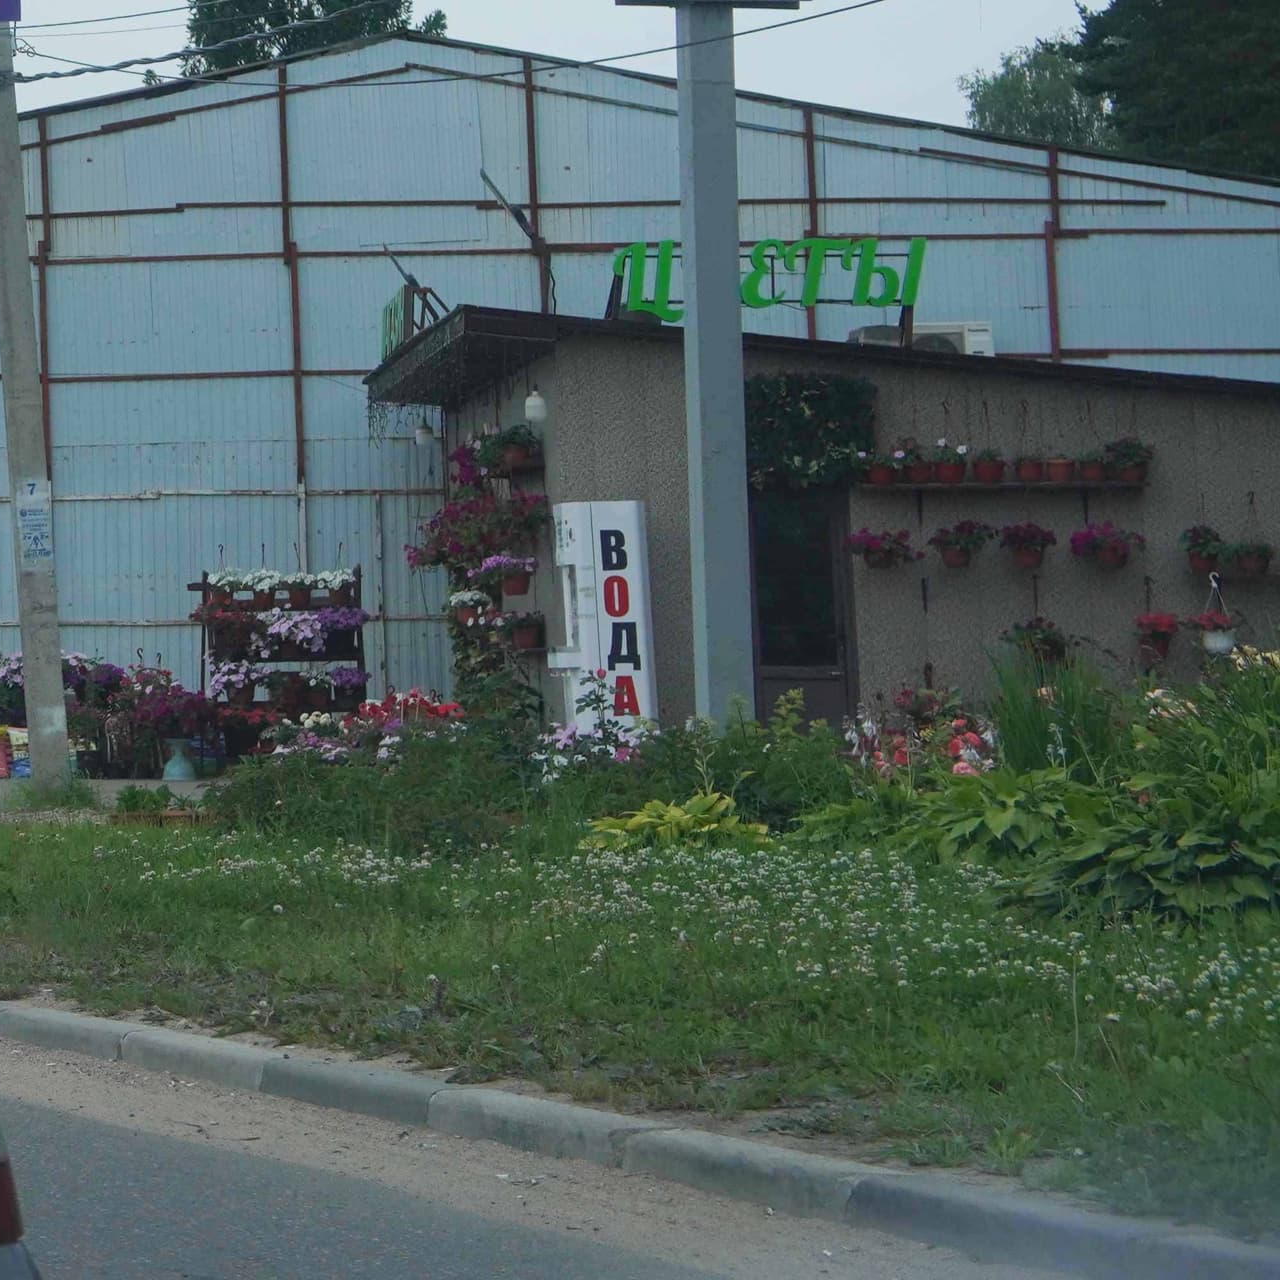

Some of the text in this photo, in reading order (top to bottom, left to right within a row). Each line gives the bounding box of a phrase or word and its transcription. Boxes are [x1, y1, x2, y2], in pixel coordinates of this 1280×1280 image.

[612, 236, 928, 323] ЦЕТЫ
[26, 483, 37, 496] 7
[599, 528, 642, 717] ВОДА
